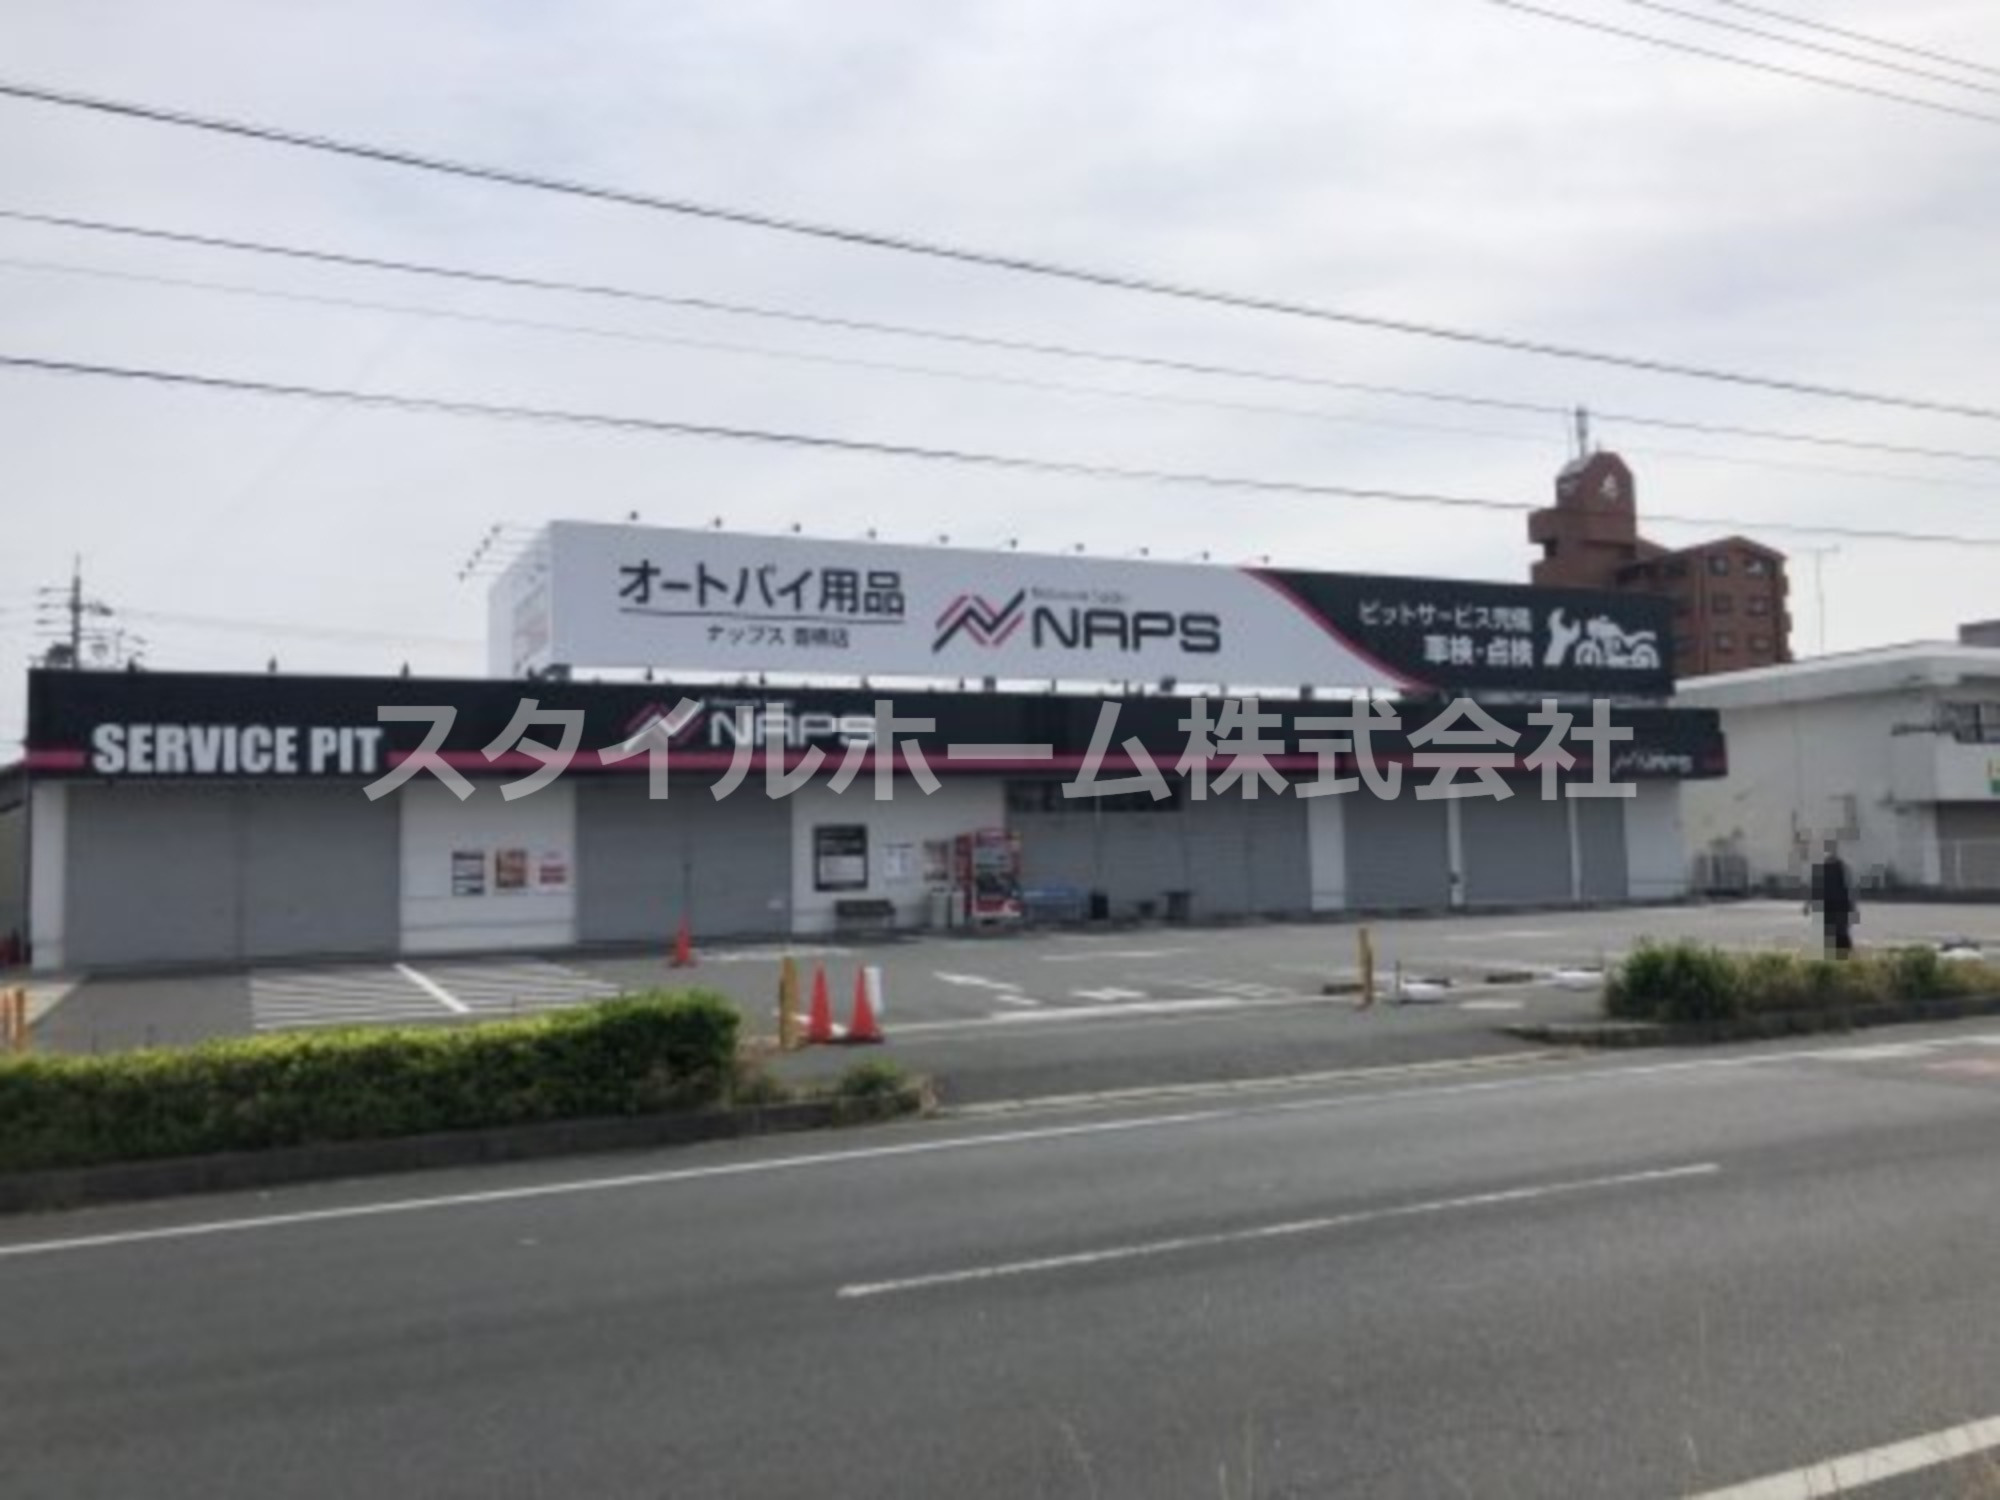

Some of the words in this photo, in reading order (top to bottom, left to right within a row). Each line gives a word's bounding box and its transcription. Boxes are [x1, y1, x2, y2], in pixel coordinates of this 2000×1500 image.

[619, 558, 905, 615] オートバイ用品
[1031, 605, 1222, 653] NAPS
[92, 723, 297, 774] SERVICE
[309, 726, 382, 774] PIT
[709, 709, 877, 748] NAPS
